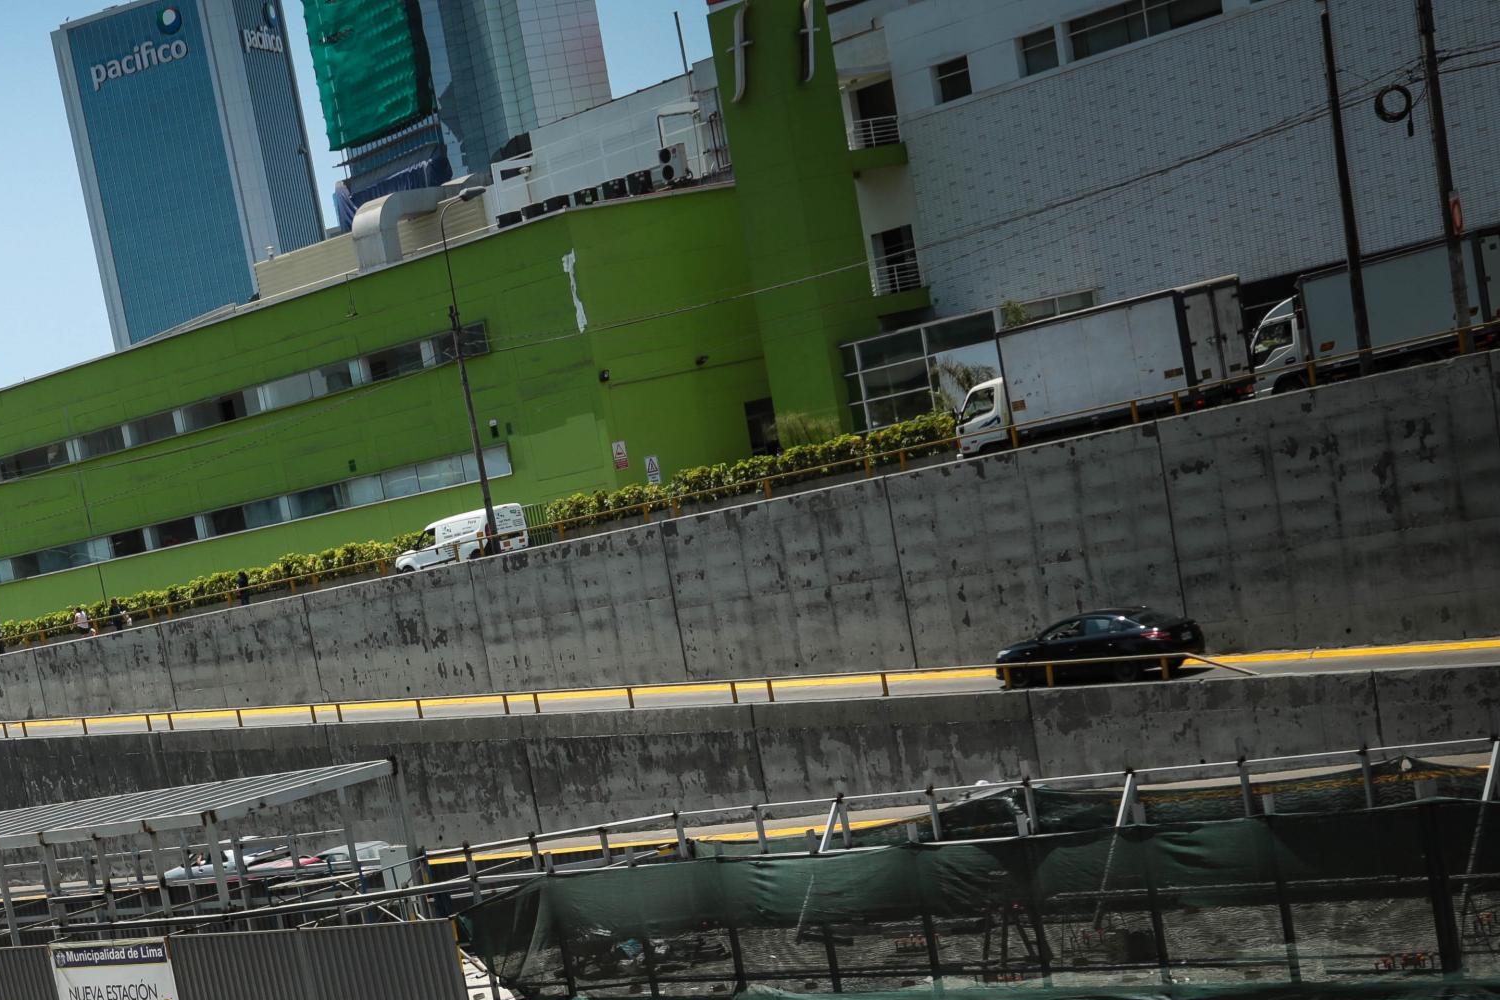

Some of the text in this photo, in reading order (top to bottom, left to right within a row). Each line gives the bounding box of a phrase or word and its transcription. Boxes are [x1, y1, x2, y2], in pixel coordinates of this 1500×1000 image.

[65, 946, 164, 963] Municipalidad de Lima
